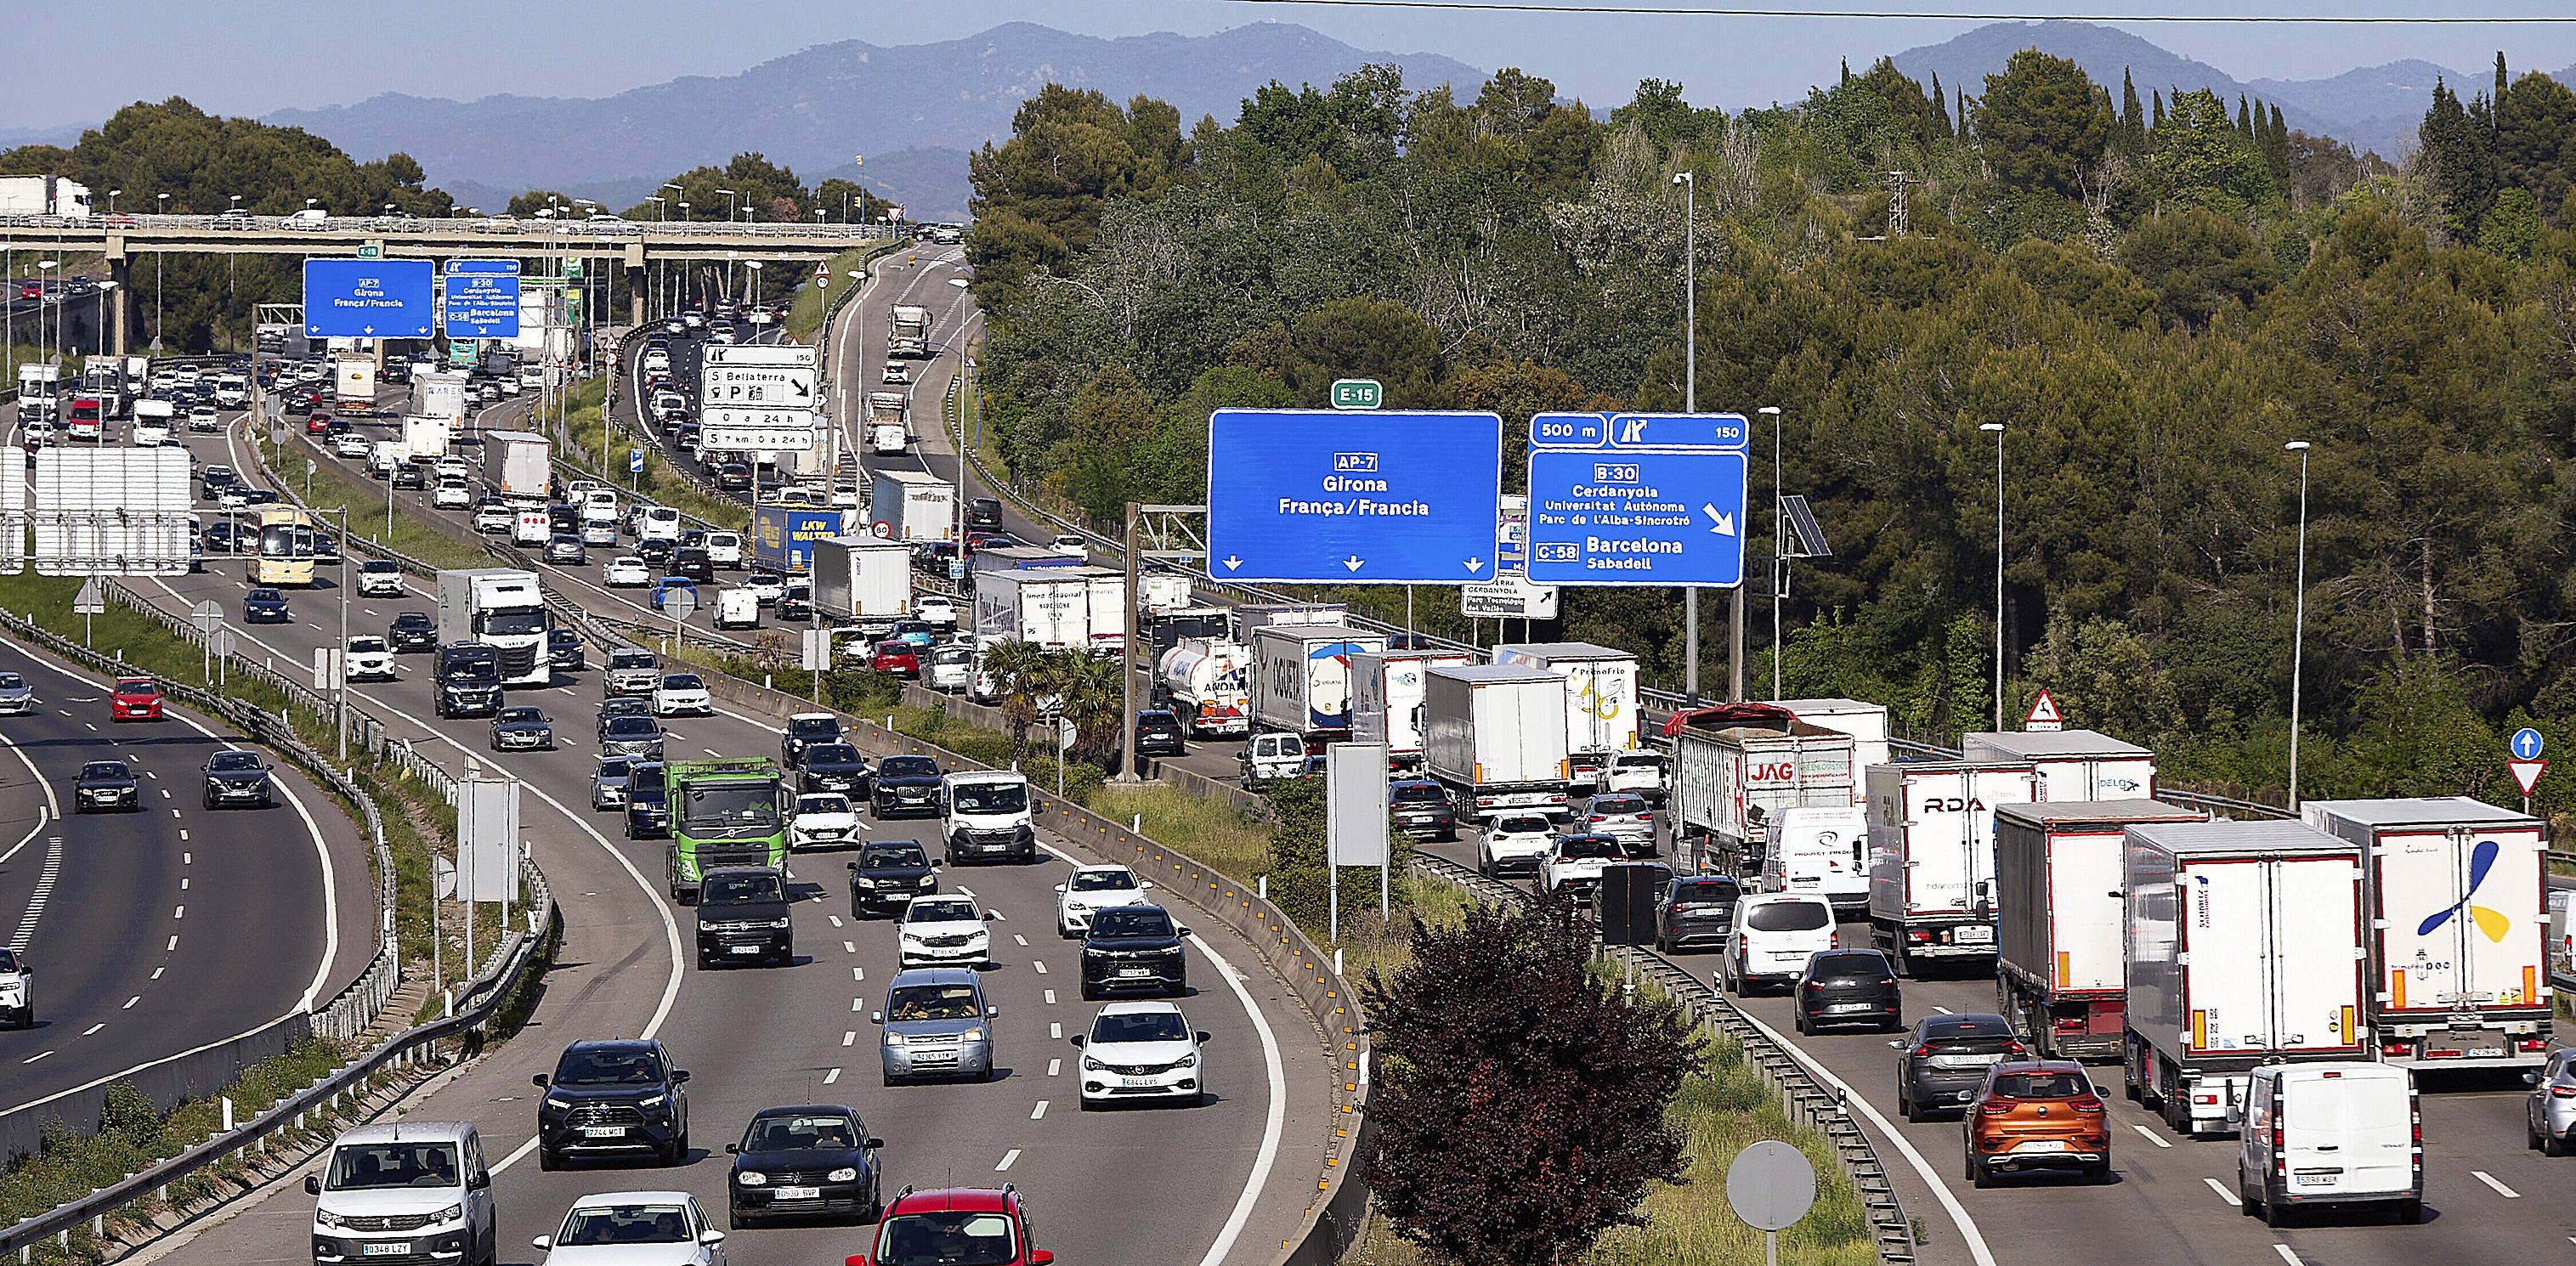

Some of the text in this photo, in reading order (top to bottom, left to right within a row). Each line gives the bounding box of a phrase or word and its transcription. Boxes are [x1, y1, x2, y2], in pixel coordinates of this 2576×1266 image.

[354, 288, 384, 297] Girona
[470, 308, 515, 317] Barcelona
[727, 371, 785, 381] Bellaterra
[1340, 387, 1373, 402] E-15
[763, 415, 779, 423] 24
[1541, 423, 1596, 438] 500 m
[1715, 427, 1740, 438] 150
[1337, 455, 1376, 468] AP-7
[1596, 466, 1636, 480] B-30
[1322, 476, 1388, 492] Girona
[1572, 484, 1658, 500] Cerdanyola
[1278, 498, 1430, 517] França/Francia
[1545, 500, 1685, 511] Universitat Autònoma
[801, 520, 826, 530] LKW
[1539, 514, 1565, 525] Parc
[1571, 515, 1587, 525] de
[1586, 536, 1684, 554] Barcelona
[1537, 545, 1577, 559] C-58
[1586, 557, 1652, 570] Sabadell
[1273, 656, 1300, 701] OGUETA
[1751, 763, 1793, 781] JAG
[1923, 797, 1987, 813] RDA
[369, 1244, 408, 1253] 0348 LZY
